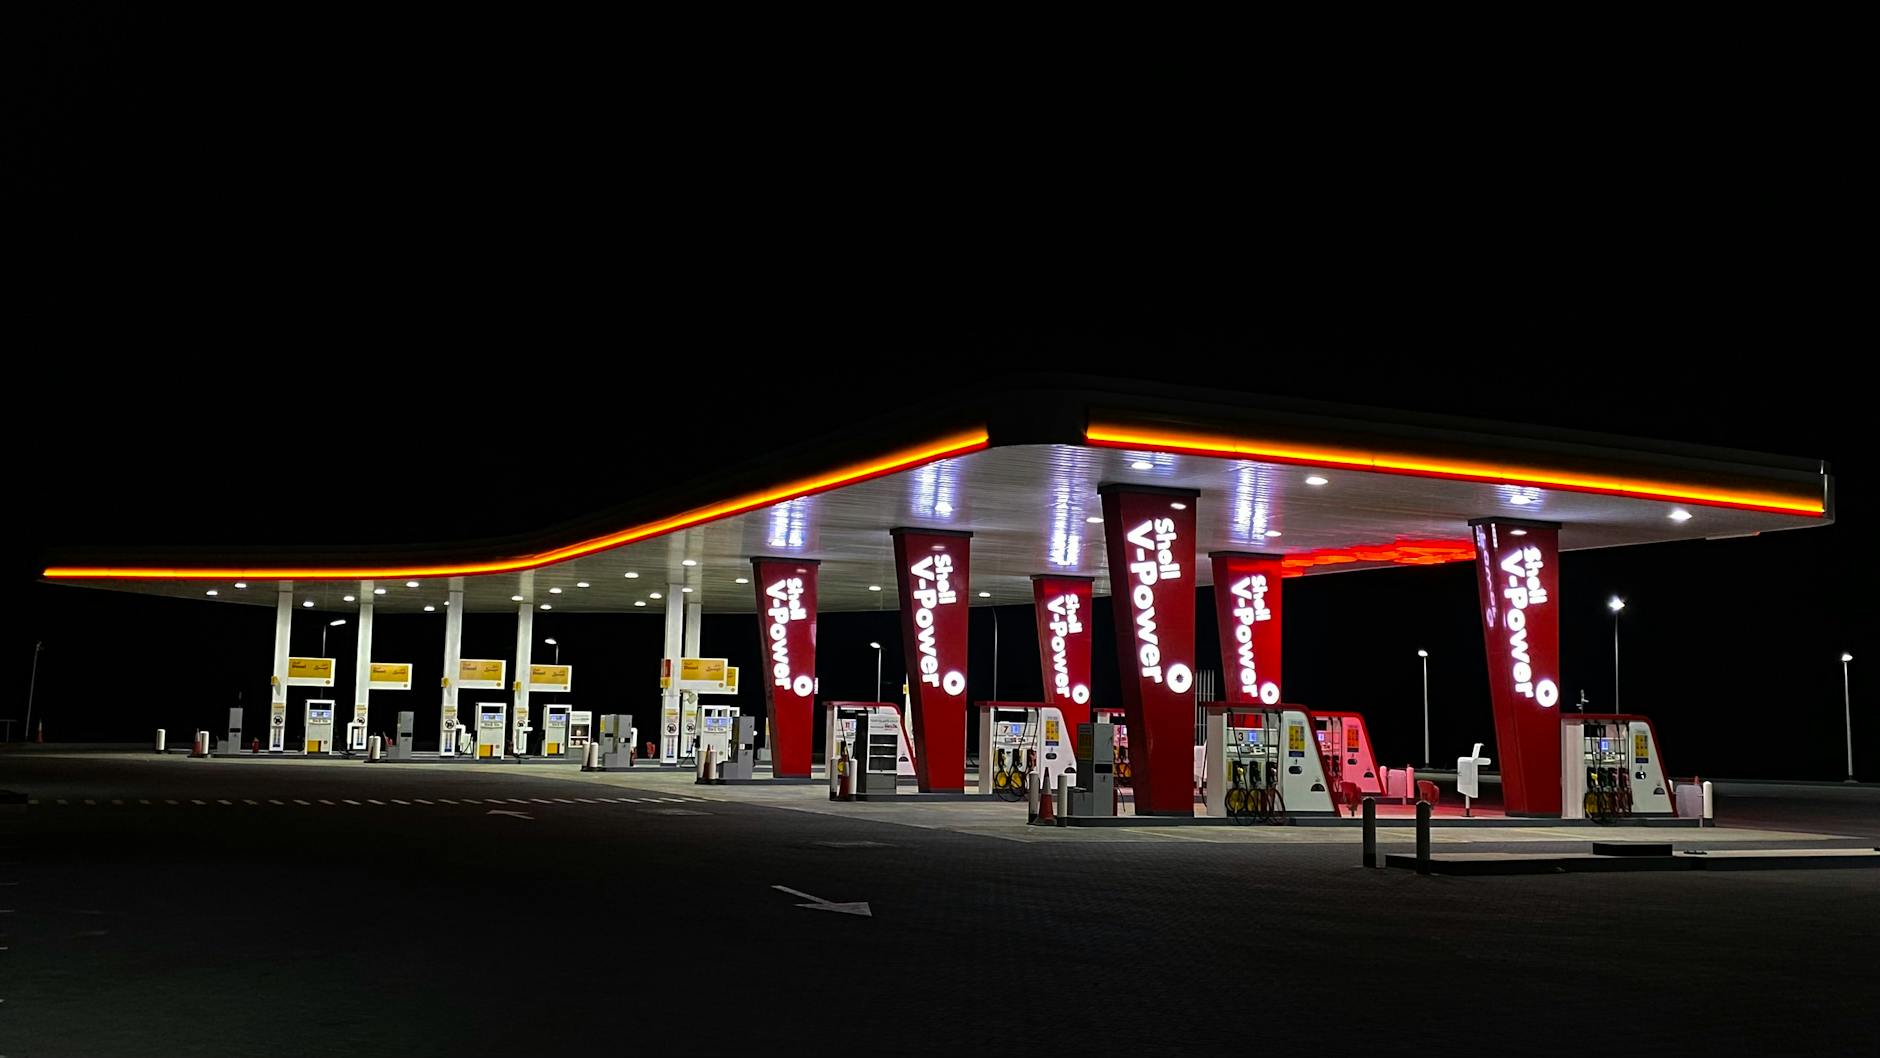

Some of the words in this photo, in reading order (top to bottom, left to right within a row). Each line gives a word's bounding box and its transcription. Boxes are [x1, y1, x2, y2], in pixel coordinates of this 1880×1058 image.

[934, 553, 957, 605] Shell
[1154, 517, 1182, 580] Shell
[1523, 545, 1548, 605] Shell
[786, 577, 807, 621] Shell
[911, 555, 940, 688] V-Power
[1065, 593, 1083, 634] Shell
[1127, 519, 1163, 684] V-Power
[1251, 574, 1272, 621] Shell
[1500, 547, 1535, 698] V-Power
[766, 579, 791, 691] V-Power
[1047, 595, 1071, 699] V-Power
[1231, 576, 1259, 698] V-Power
[1003, 725, 1010, 735] 7
[1238, 732, 1245, 742] 3
